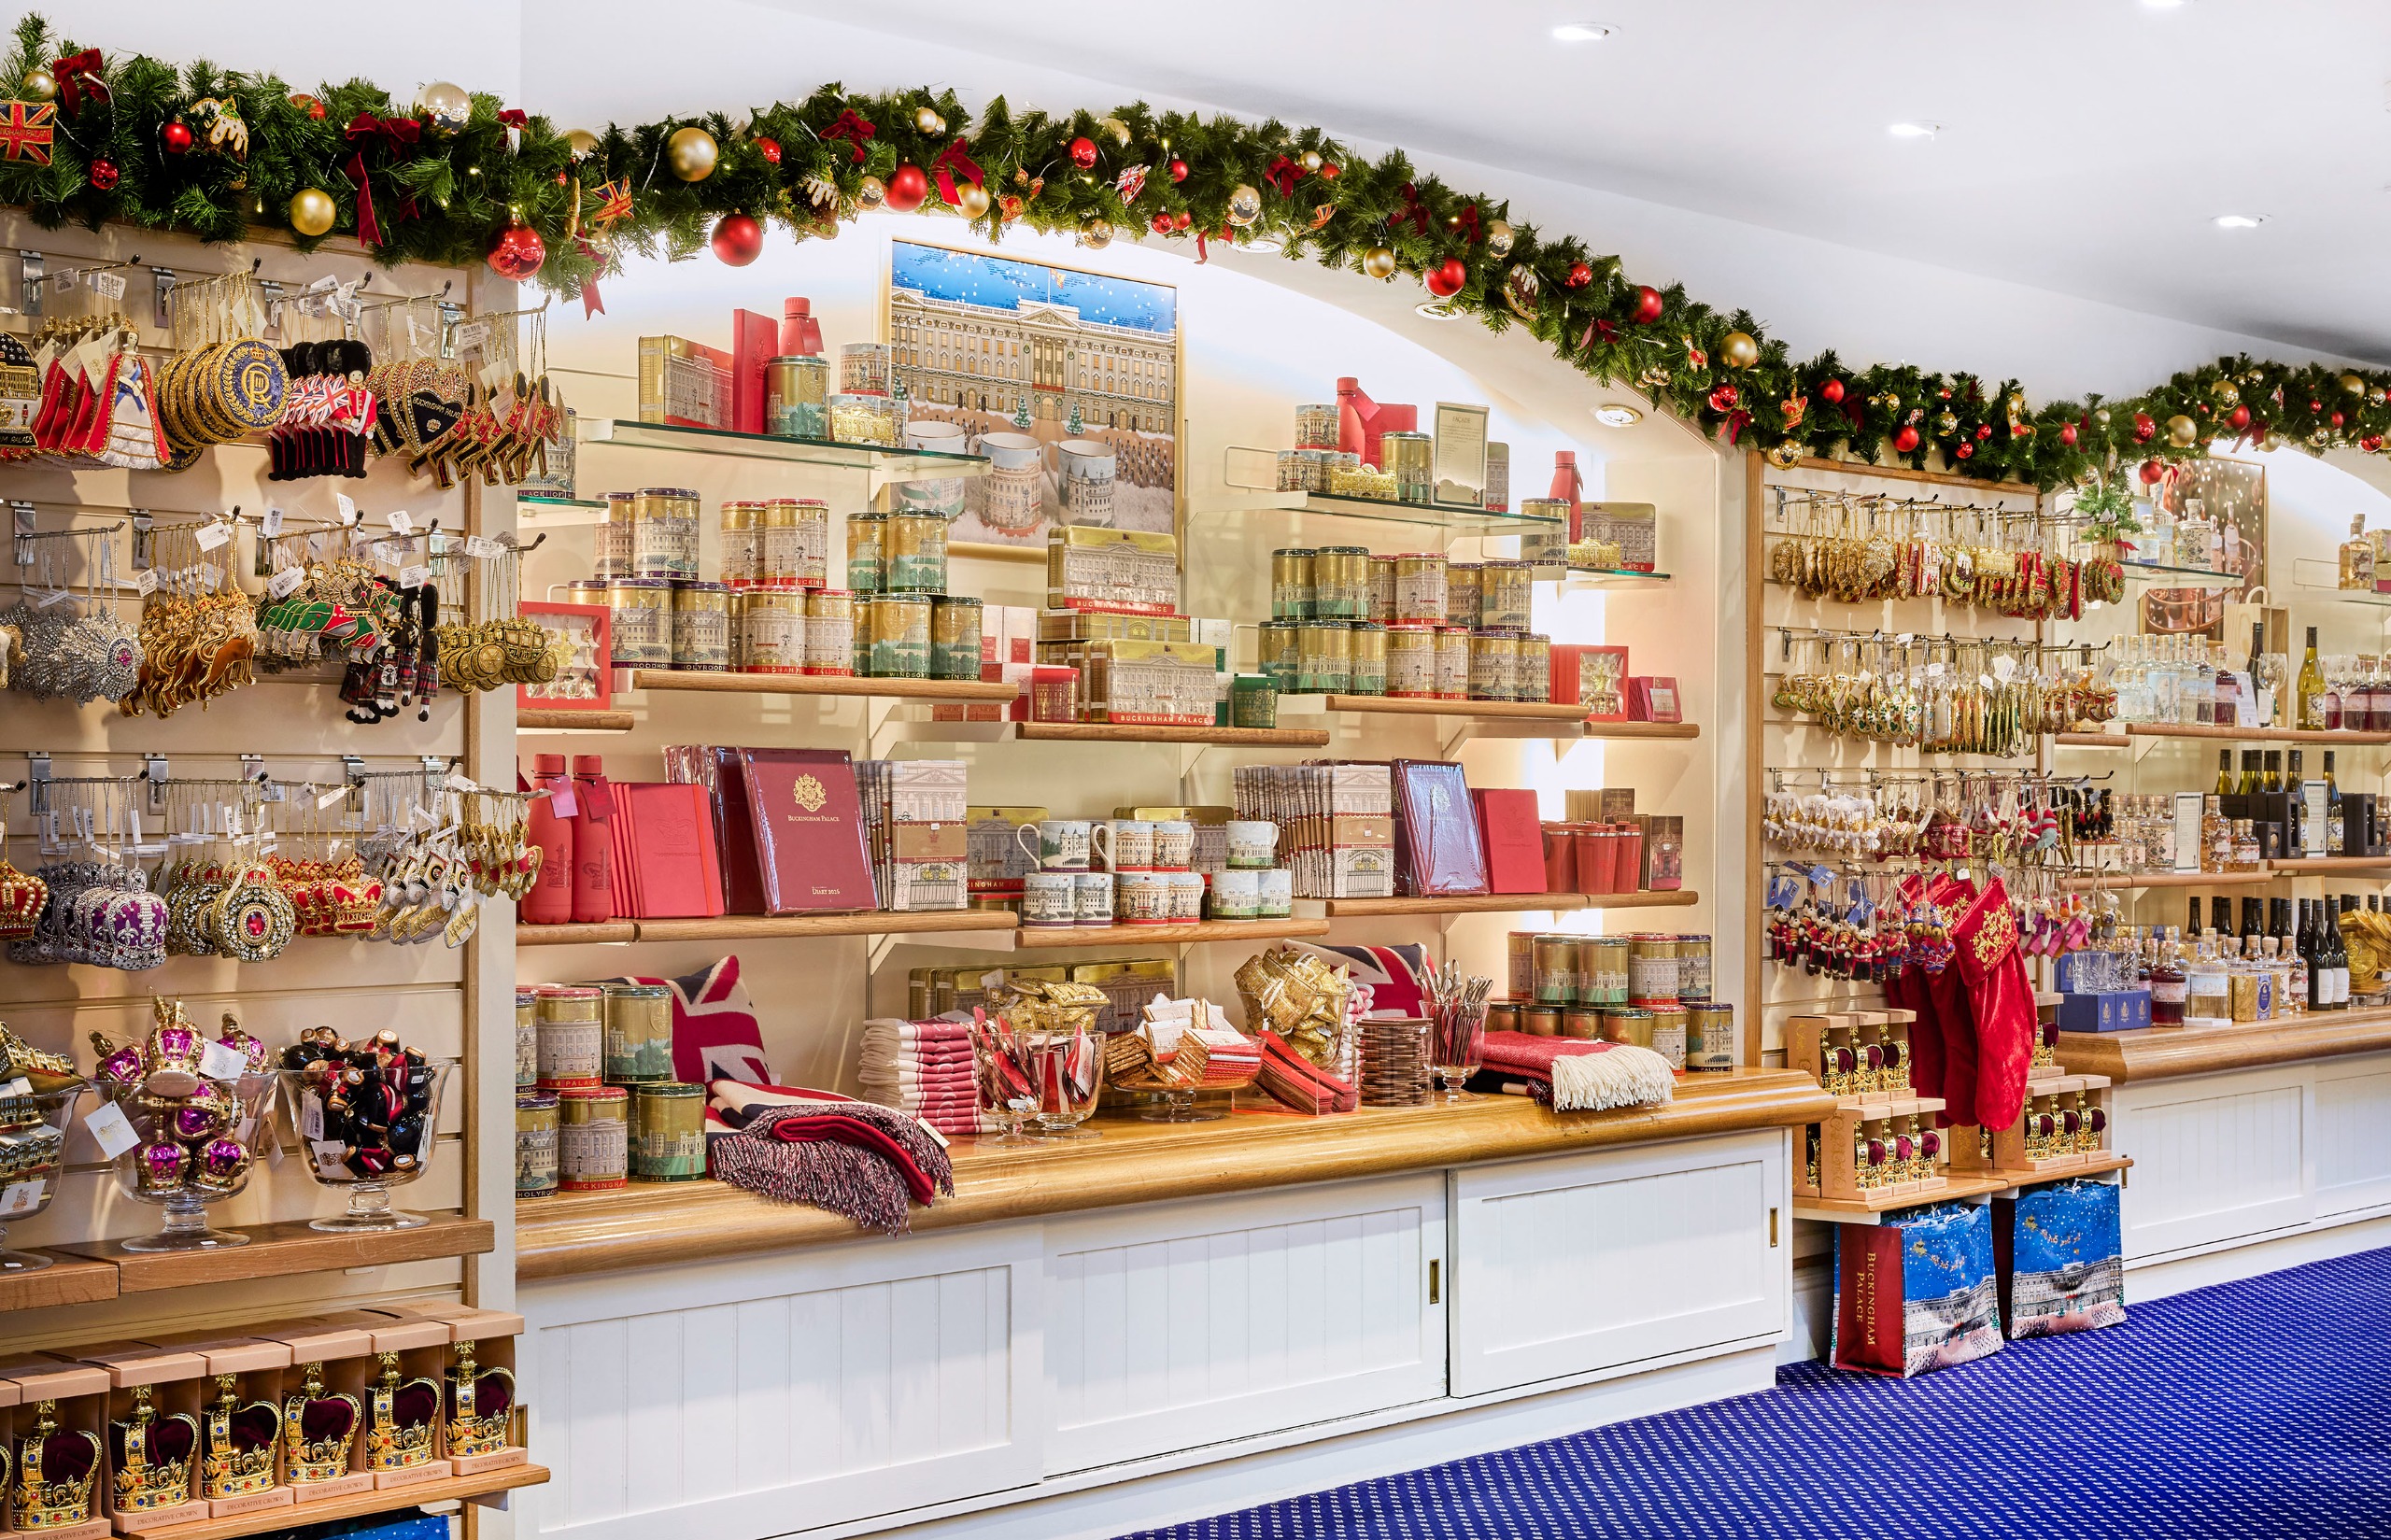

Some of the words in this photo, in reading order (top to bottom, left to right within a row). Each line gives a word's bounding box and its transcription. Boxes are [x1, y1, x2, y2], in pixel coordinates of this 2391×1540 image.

[1120, 714, 1174, 723] BUCKINGHAM
[565, 1079, 598, 1087] PALACE
[1856, 1271, 1865, 1322] PALACE
[1867, 1251, 1876, 1346] BUCKINGHAM
[471, 1458, 502, 1468] DECORATIVE
[501, 1455, 520, 1463] CROWN
[389, 1472, 422, 1483] DECORATIVE
[422, 1468, 444, 1478] CROWN
[307, 1485, 343, 1496] DECORATIVE
[343, 1481, 364, 1490] CROWN
[226, 1499, 263, 1510] DECORATIVE
[262, 1496, 285, 1505] CROWN
[136, 1512, 175, 1526] DECORATIVE
[175, 1509, 198, 1519] CROWN
[37, 1529, 78, 1540] DECORATIVE
[78, 1528, 101, 1538] CROWN
